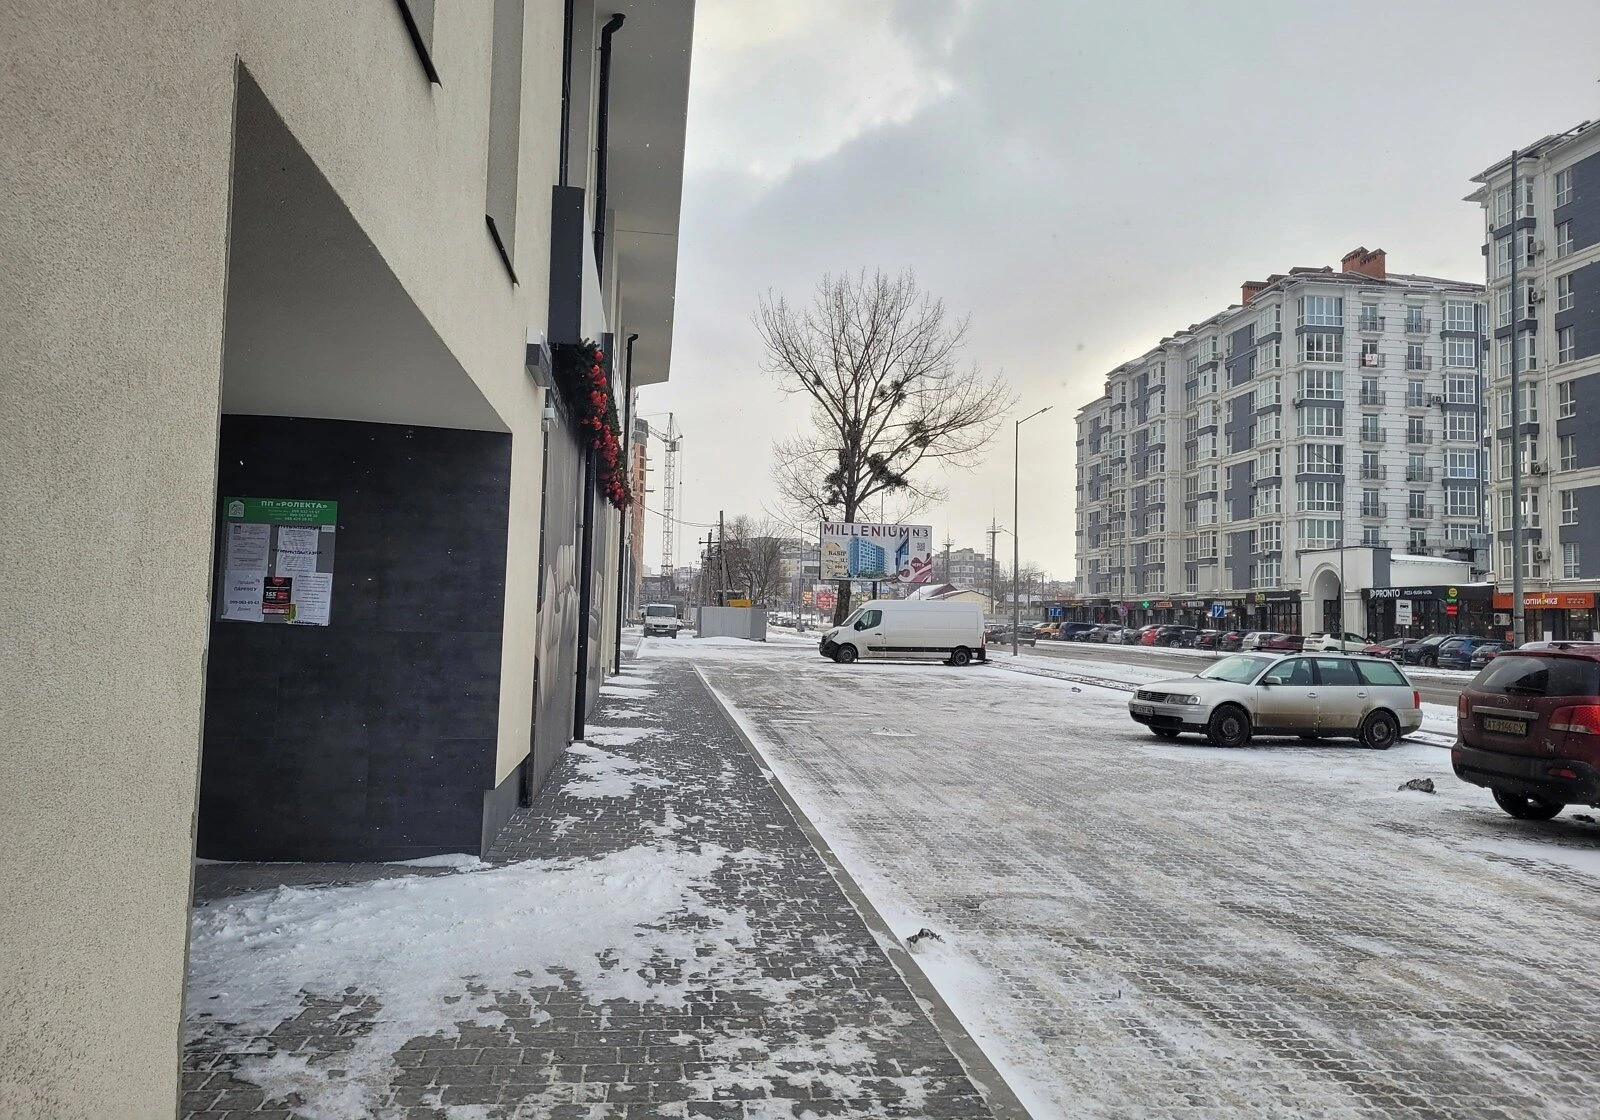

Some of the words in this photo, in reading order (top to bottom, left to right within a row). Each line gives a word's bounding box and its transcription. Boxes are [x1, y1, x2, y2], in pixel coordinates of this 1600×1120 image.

[824, 524, 910, 537] MILLENIUM
[923, 529, 929, 537] 3
[1375, 589, 1401, 598] PRONTO
